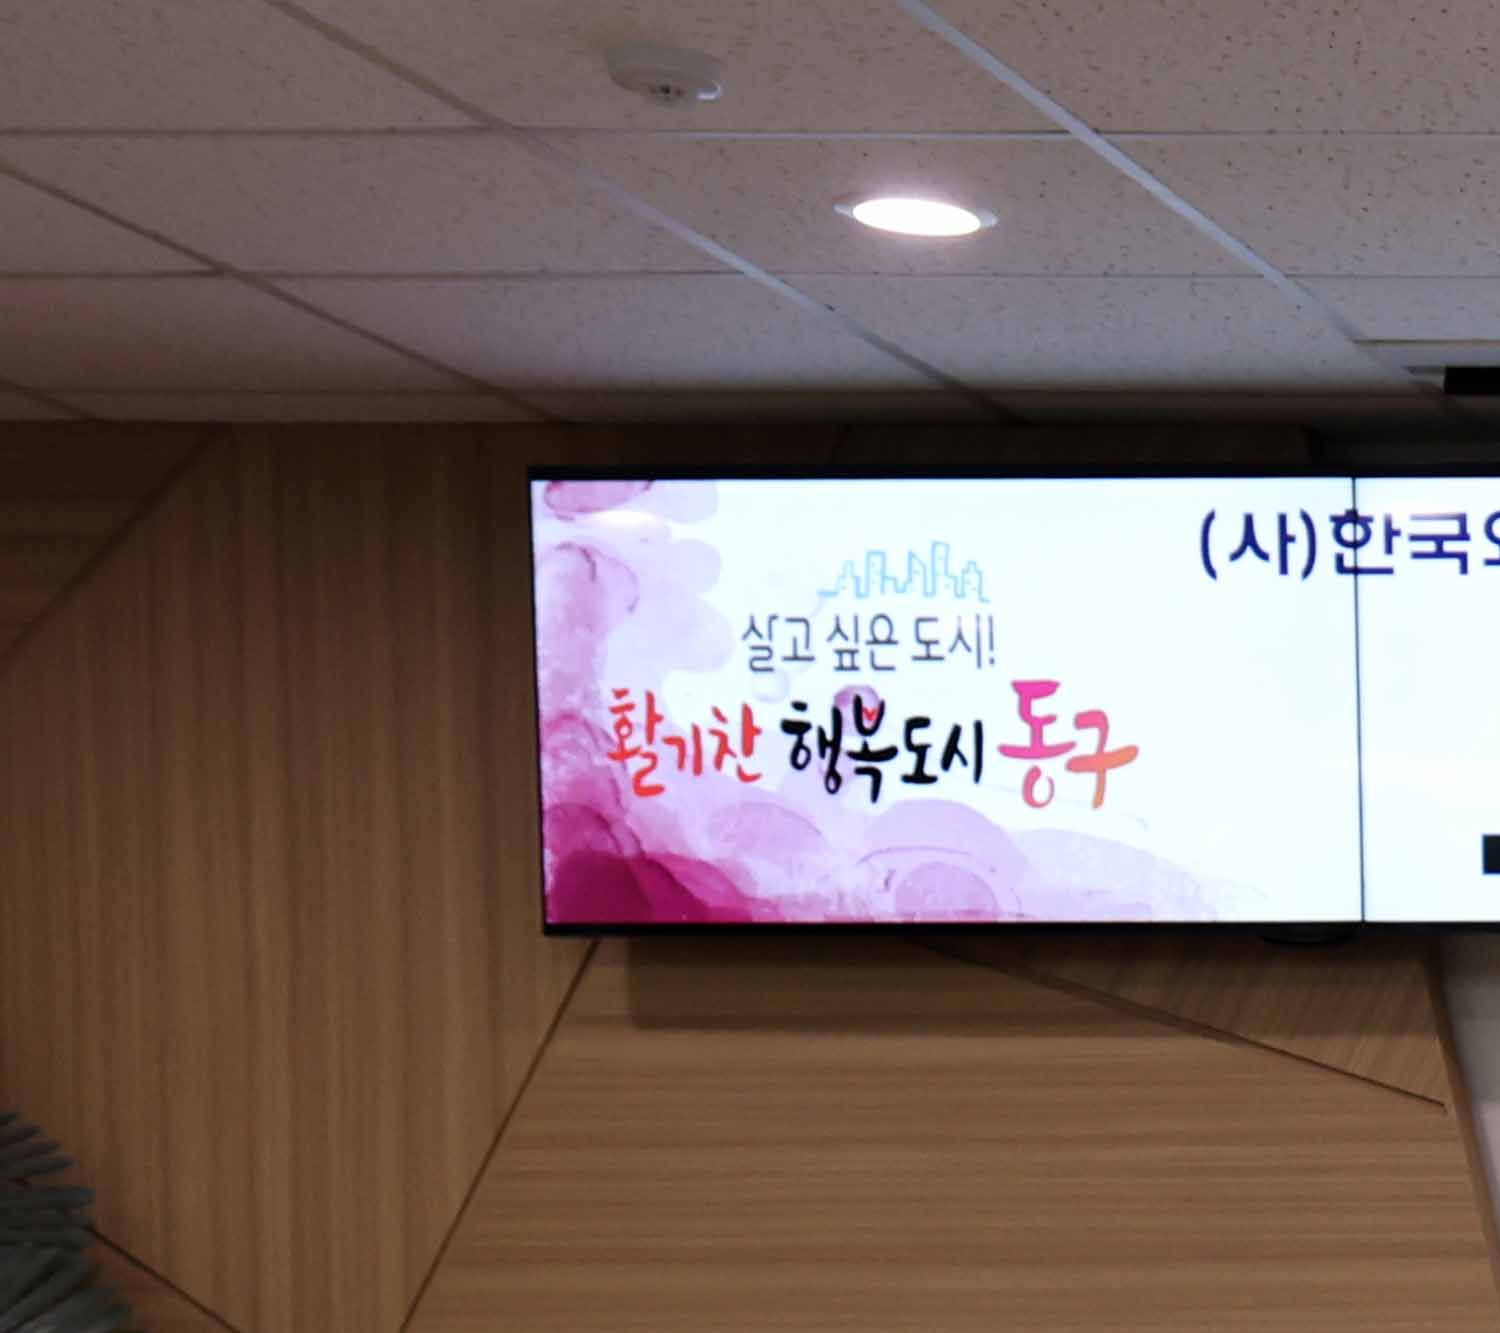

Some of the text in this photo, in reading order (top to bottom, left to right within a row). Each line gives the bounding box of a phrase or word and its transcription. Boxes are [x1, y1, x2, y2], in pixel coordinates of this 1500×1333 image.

[741, 613, 997, 672] 살고 싶은 도시!
[604, 679, 1140, 809] 활기찬 행복도시 동구
